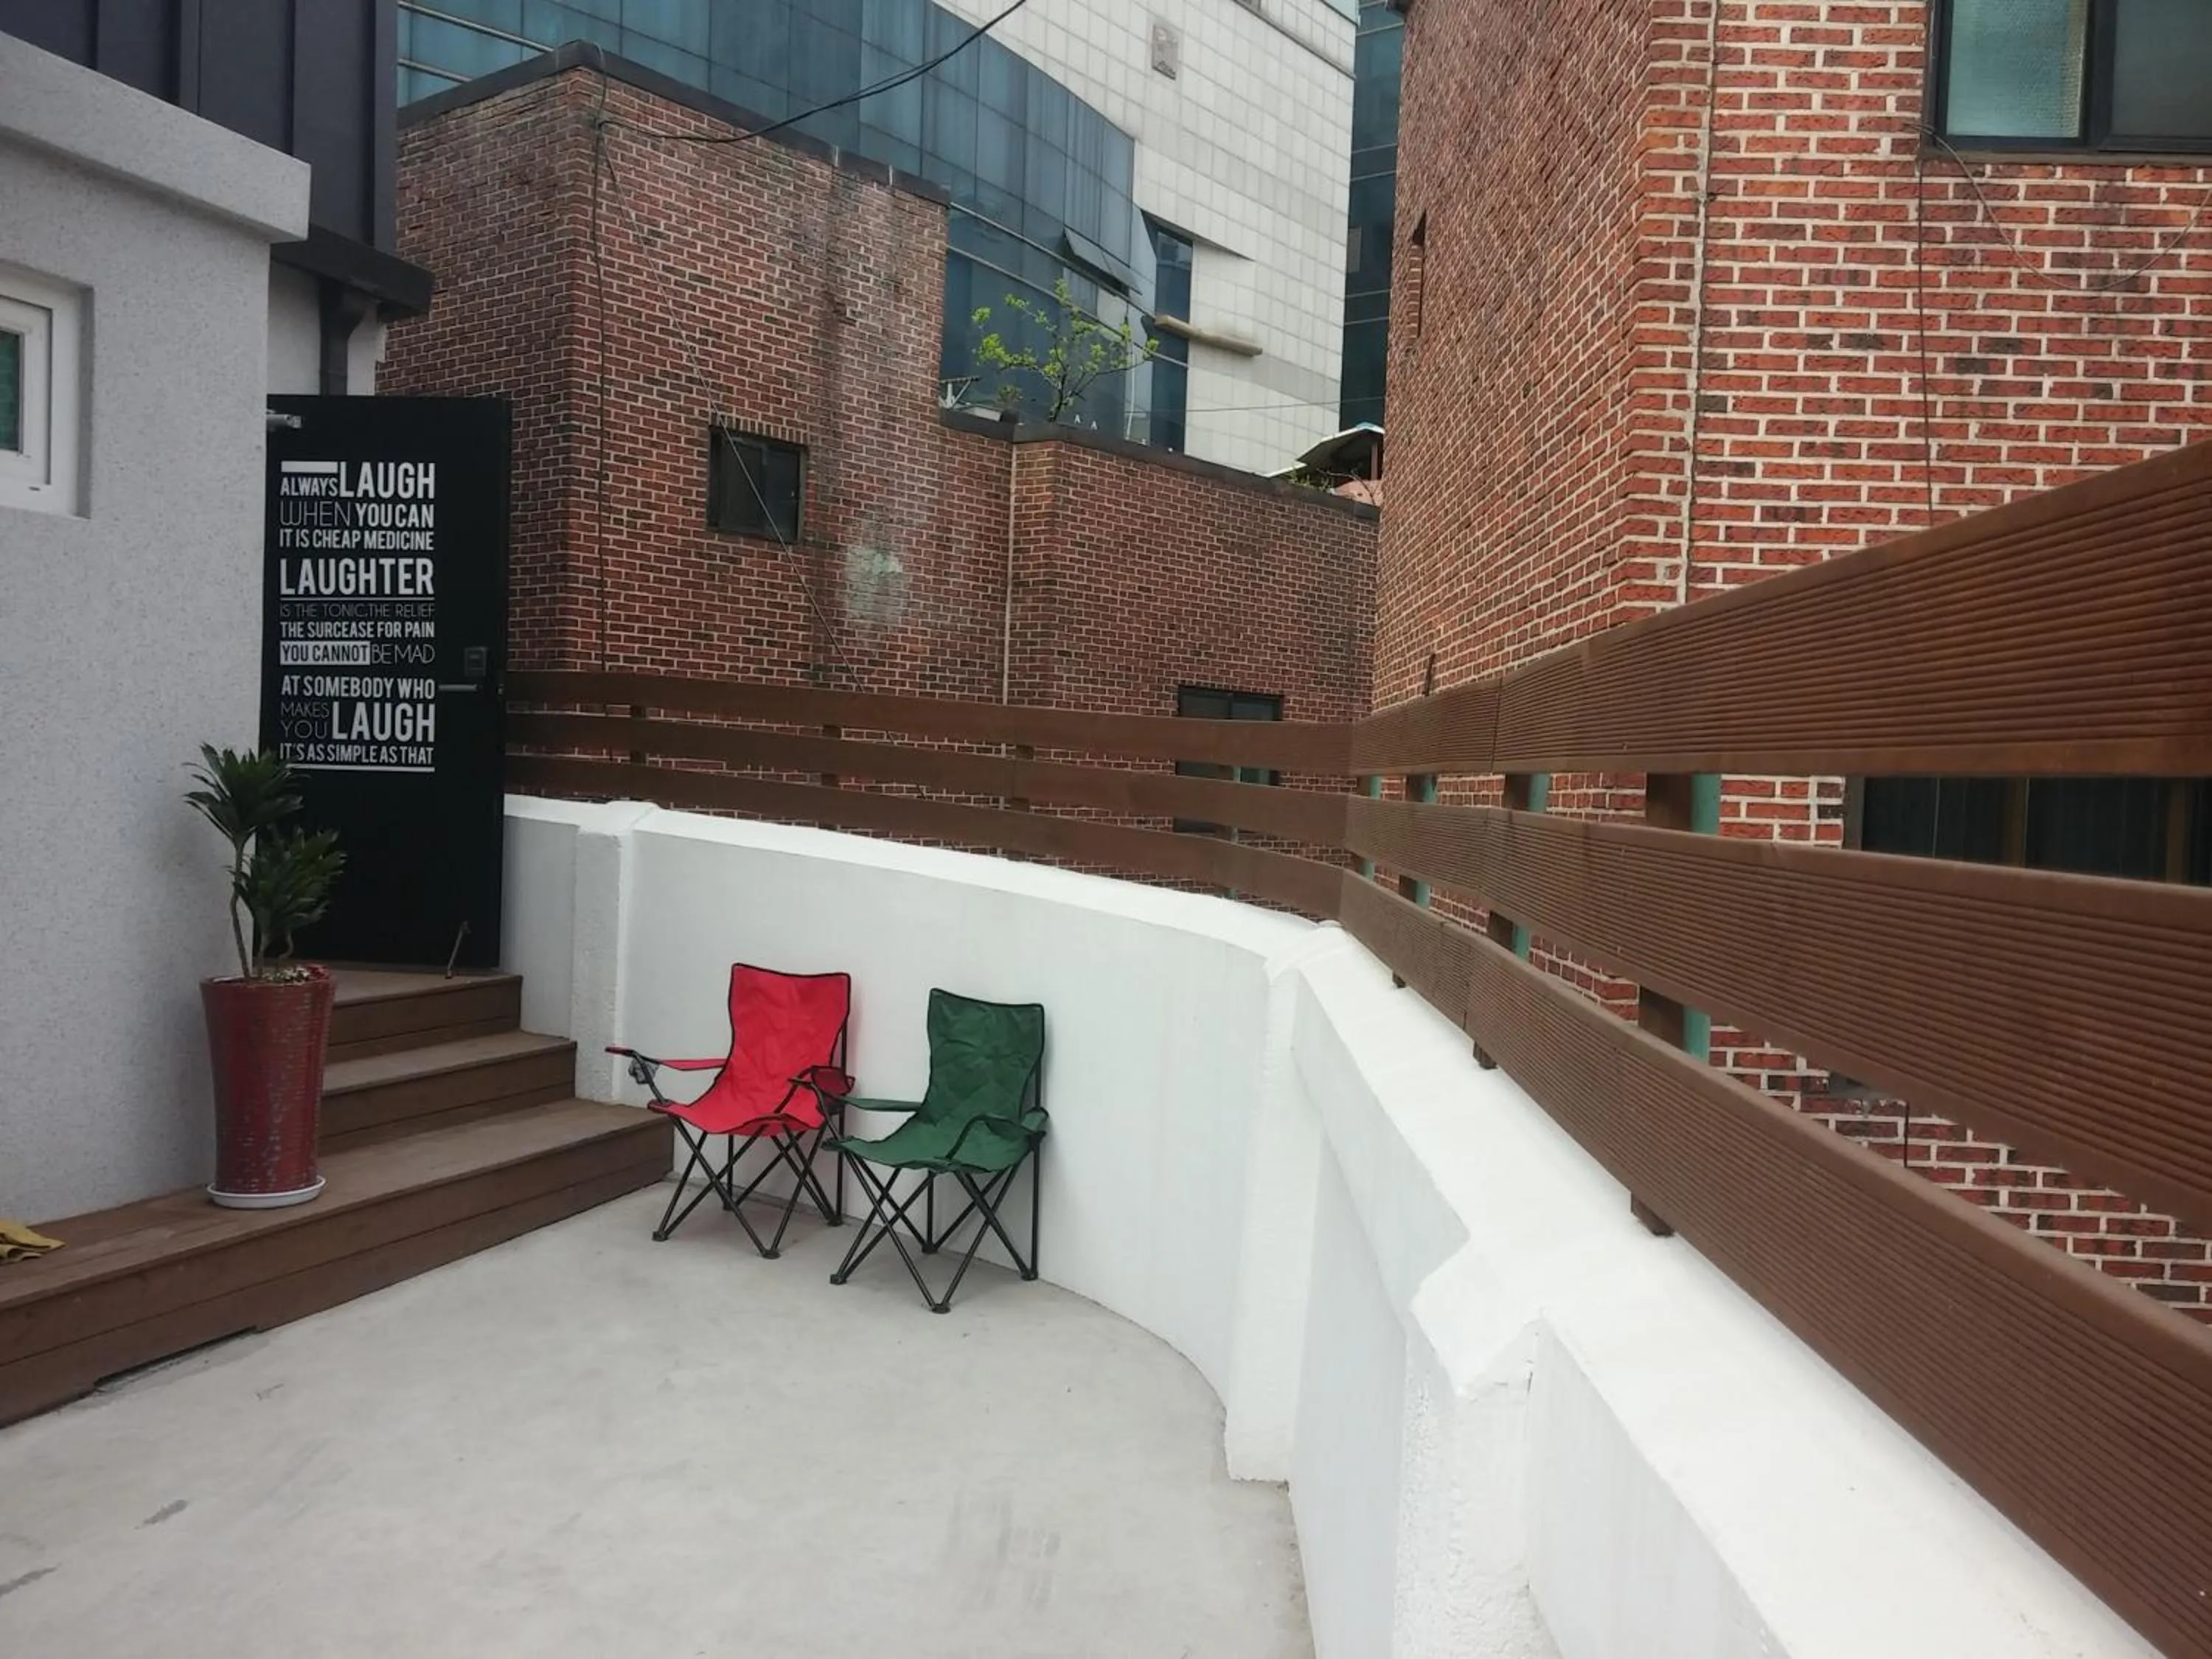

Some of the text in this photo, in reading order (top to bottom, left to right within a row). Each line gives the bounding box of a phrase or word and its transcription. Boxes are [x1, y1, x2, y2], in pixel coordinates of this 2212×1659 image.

[280, 462, 435, 499] ALWAYS LAUGH
[280, 501, 434, 528] WHEN YOU CAN
[279, 529, 434, 551] IT IS CHEAP MEDICINE
[280, 557, 434, 595] LAUGHTER
[280, 622, 434, 638] THE SURCEASE FOR PAIN
[282, 644, 435, 664] YOU CANNOT BE MAD
[281, 675, 435, 699] AT SOMEBODY WHO
[281, 702, 330, 717] MAKES
[281, 720, 327, 739] YOU
[333, 701, 435, 742] LAUGH
[306, 743, 325, 762] AS
[327, 744, 378, 763] SIMPLE
[380, 745, 397, 763] AS
[400, 746, 434, 765] THAT
